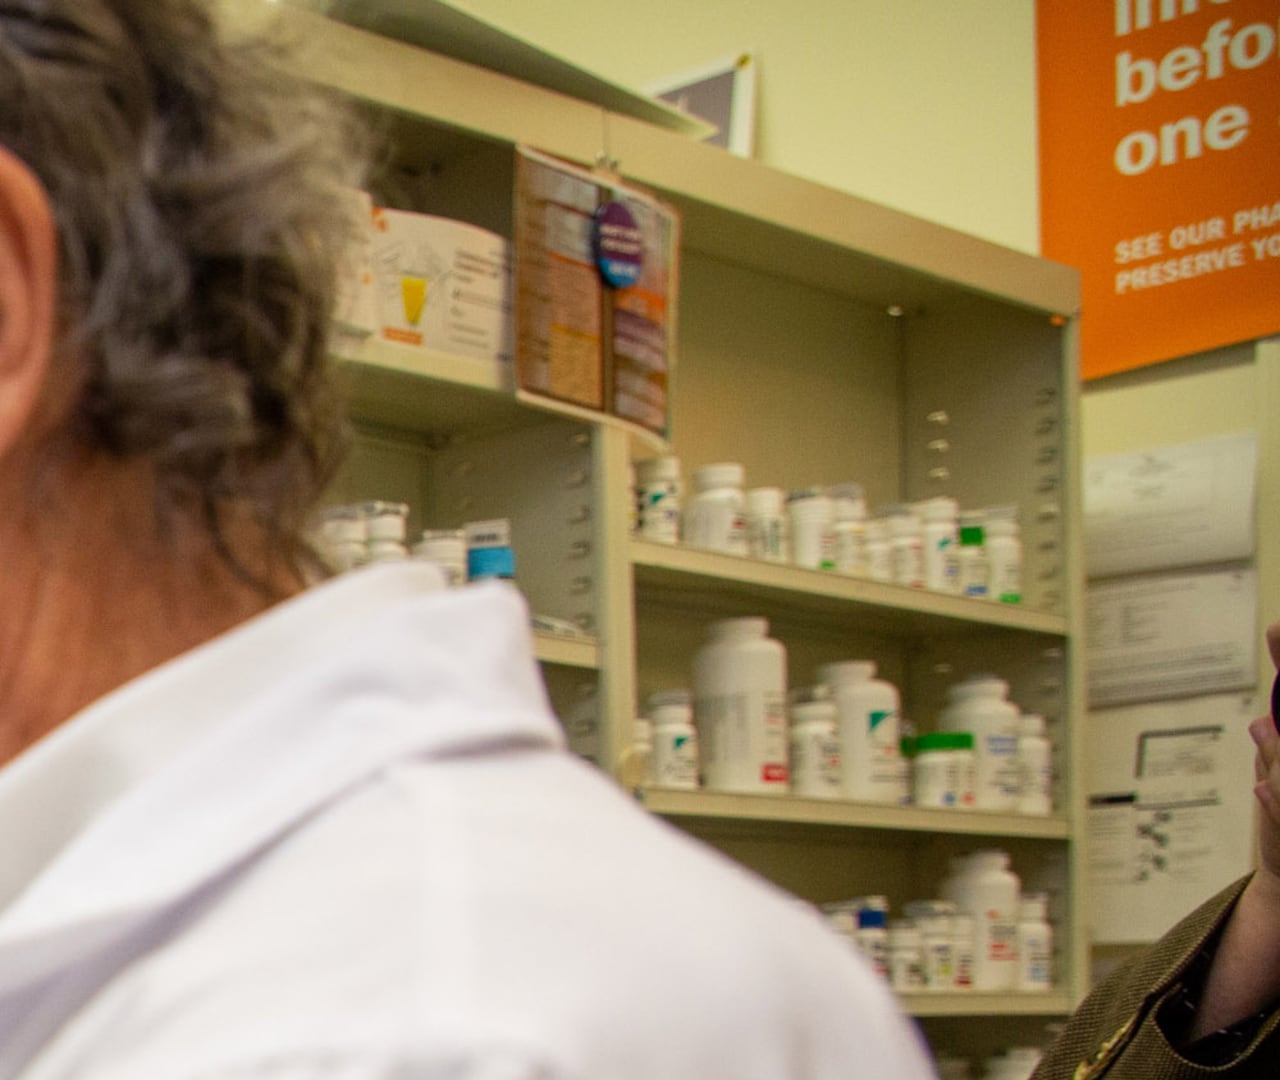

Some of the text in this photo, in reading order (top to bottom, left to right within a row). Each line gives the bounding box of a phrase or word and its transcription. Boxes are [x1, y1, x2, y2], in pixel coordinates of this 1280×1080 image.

[1115, 18, 1280, 107] befo
[1114, 104, 1250, 176] one
[1114, 232, 1162, 264] SEE
[1169, 217, 1225, 250] OUR
[1115, 245, 1245, 294] PRESERVE
